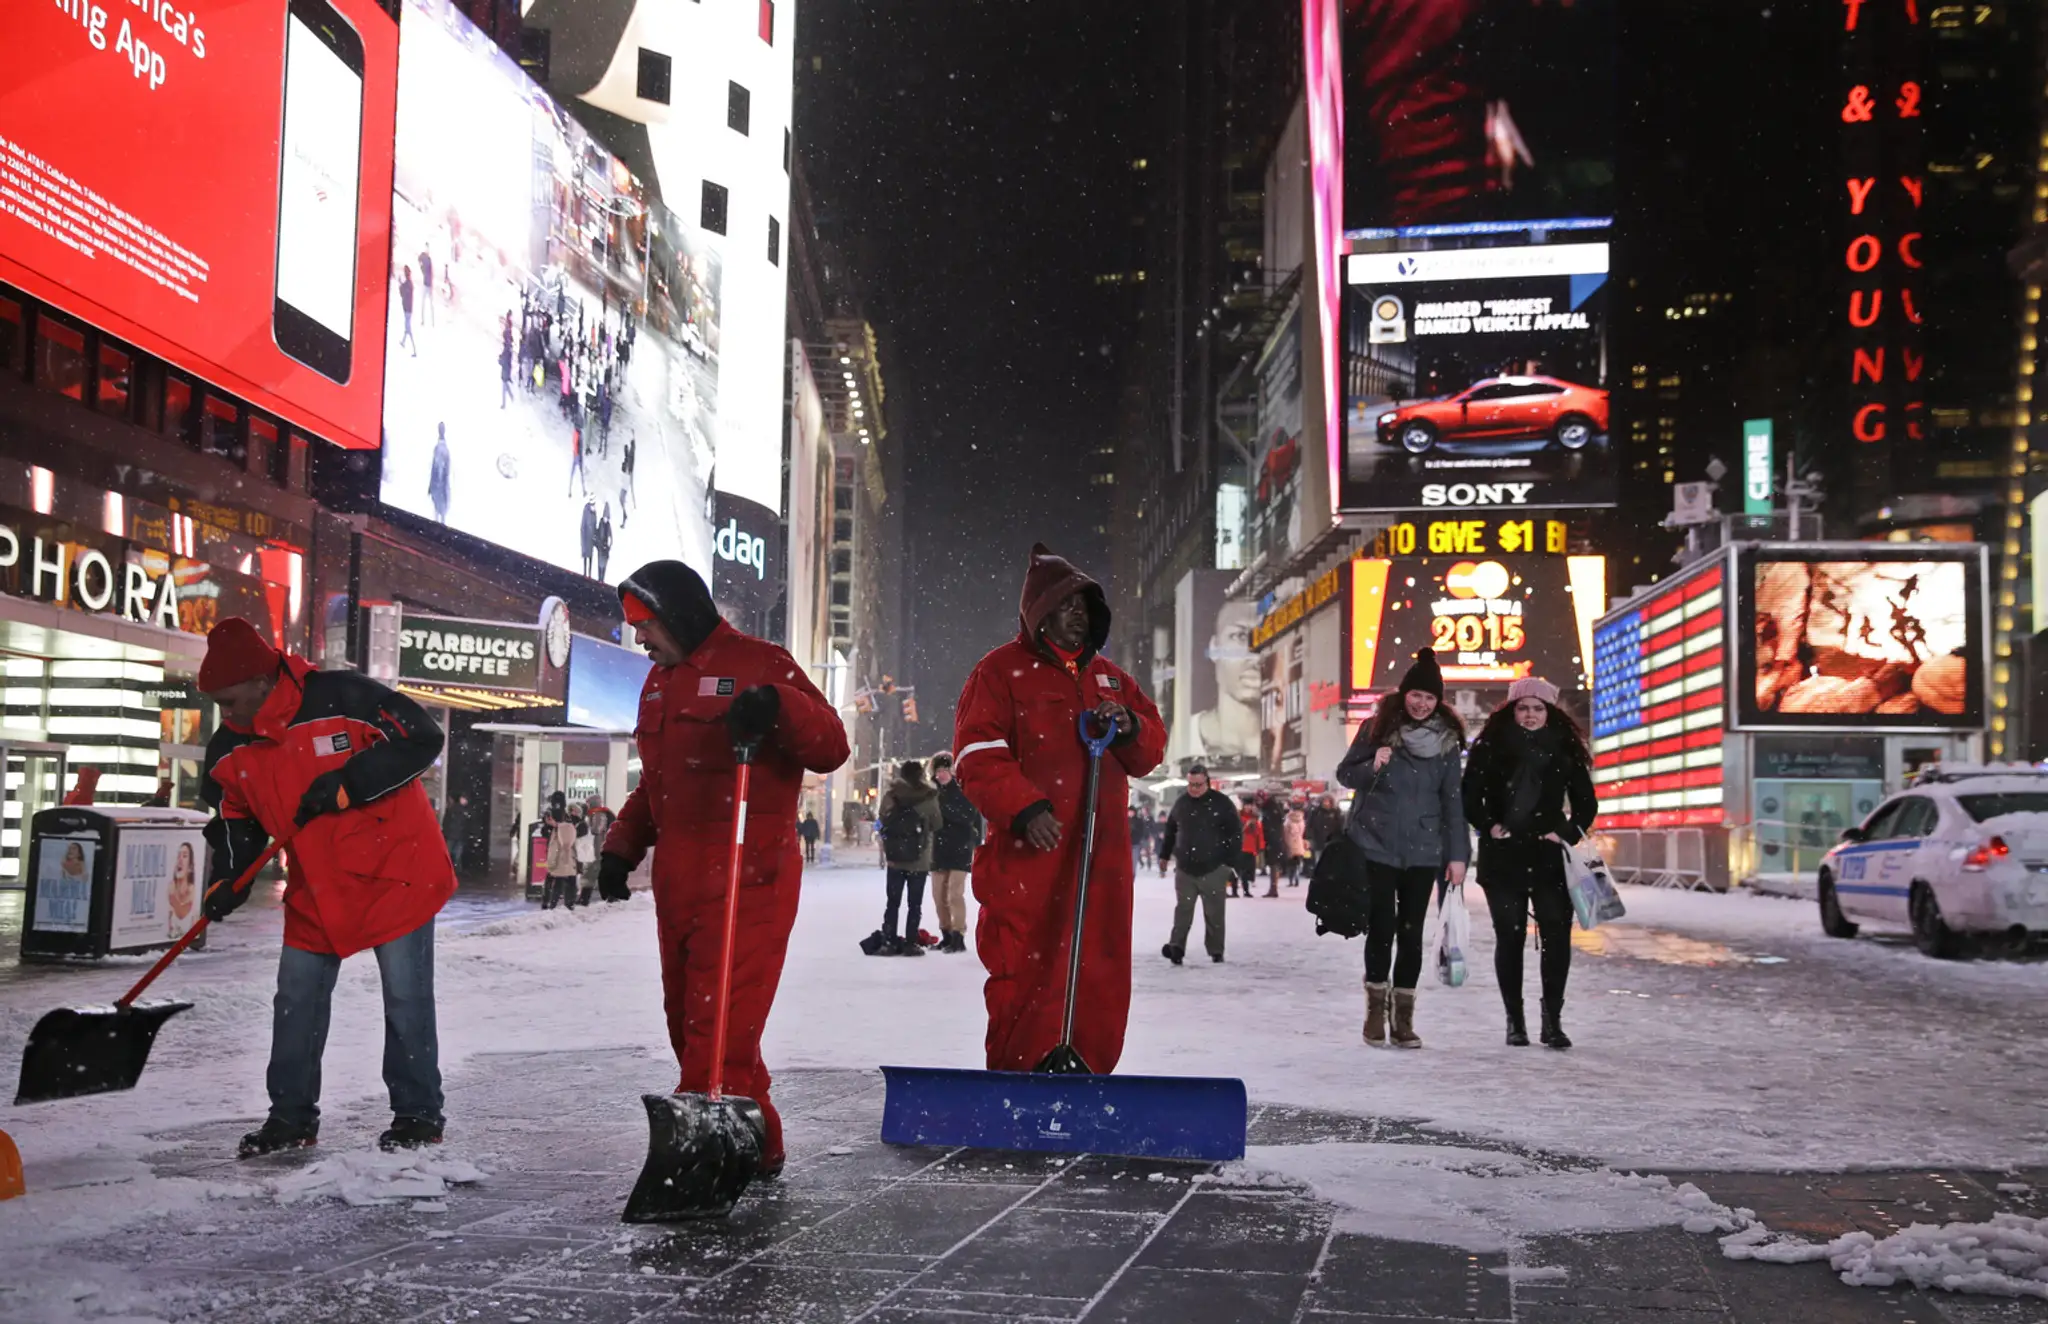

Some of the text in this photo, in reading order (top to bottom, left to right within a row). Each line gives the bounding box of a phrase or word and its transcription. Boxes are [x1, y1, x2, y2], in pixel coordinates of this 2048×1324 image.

[115, 18, 166, 91] App
[1841, 85, 1876, 123] &
[1846, 177, 1889, 442] YOUNG
[1422, 483, 1535, 506] SONY
[1388, 522, 1416, 554] TO
[1428, 521, 1486, 554] GIVE
[1498, 520, 1534, 553] $1
[399, 629, 535, 660] STARBUCKS
[1431, 614, 1526, 652] 2015
[423, 652, 510, 676] COFFEE
